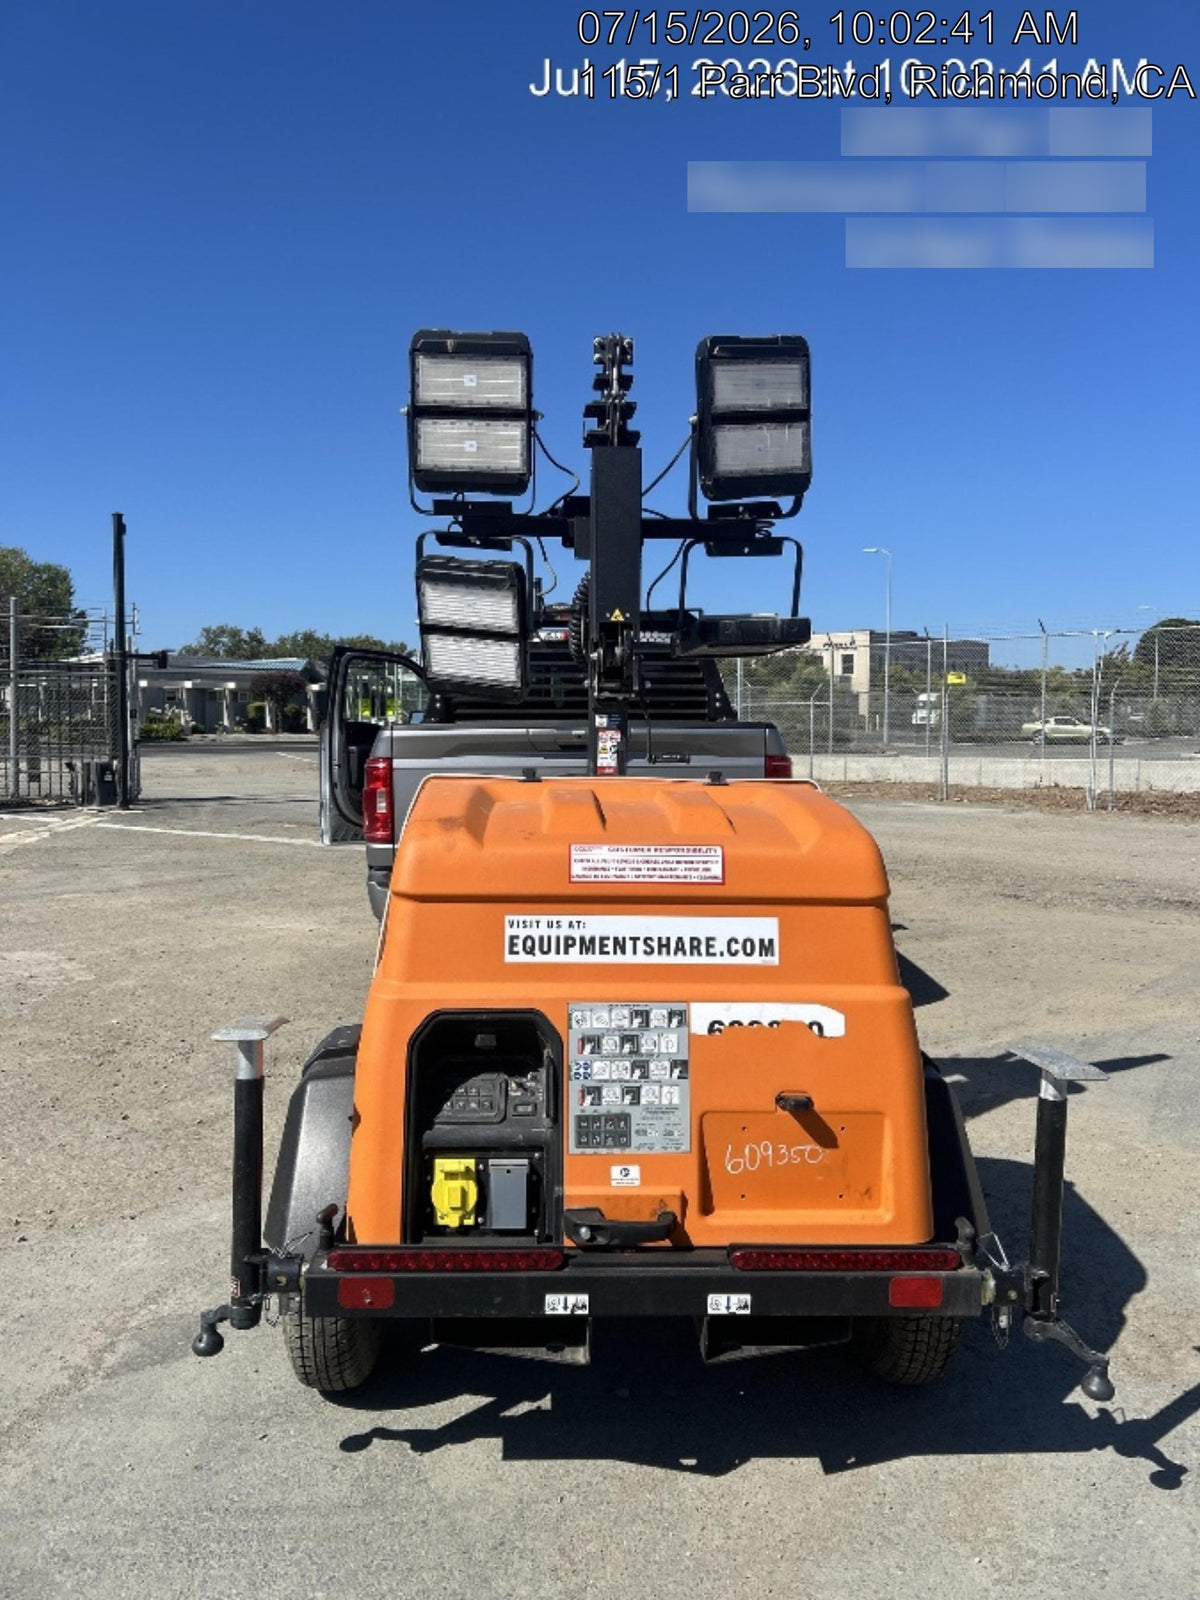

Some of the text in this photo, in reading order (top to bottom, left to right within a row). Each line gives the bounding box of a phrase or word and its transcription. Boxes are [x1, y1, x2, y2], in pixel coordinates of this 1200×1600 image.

[508, 919, 587, 930] VISIT US AT:
[507, 933, 776, 958] EQUIPMENTSHARE.COM
[725, 1140, 822, 1174] 609350
